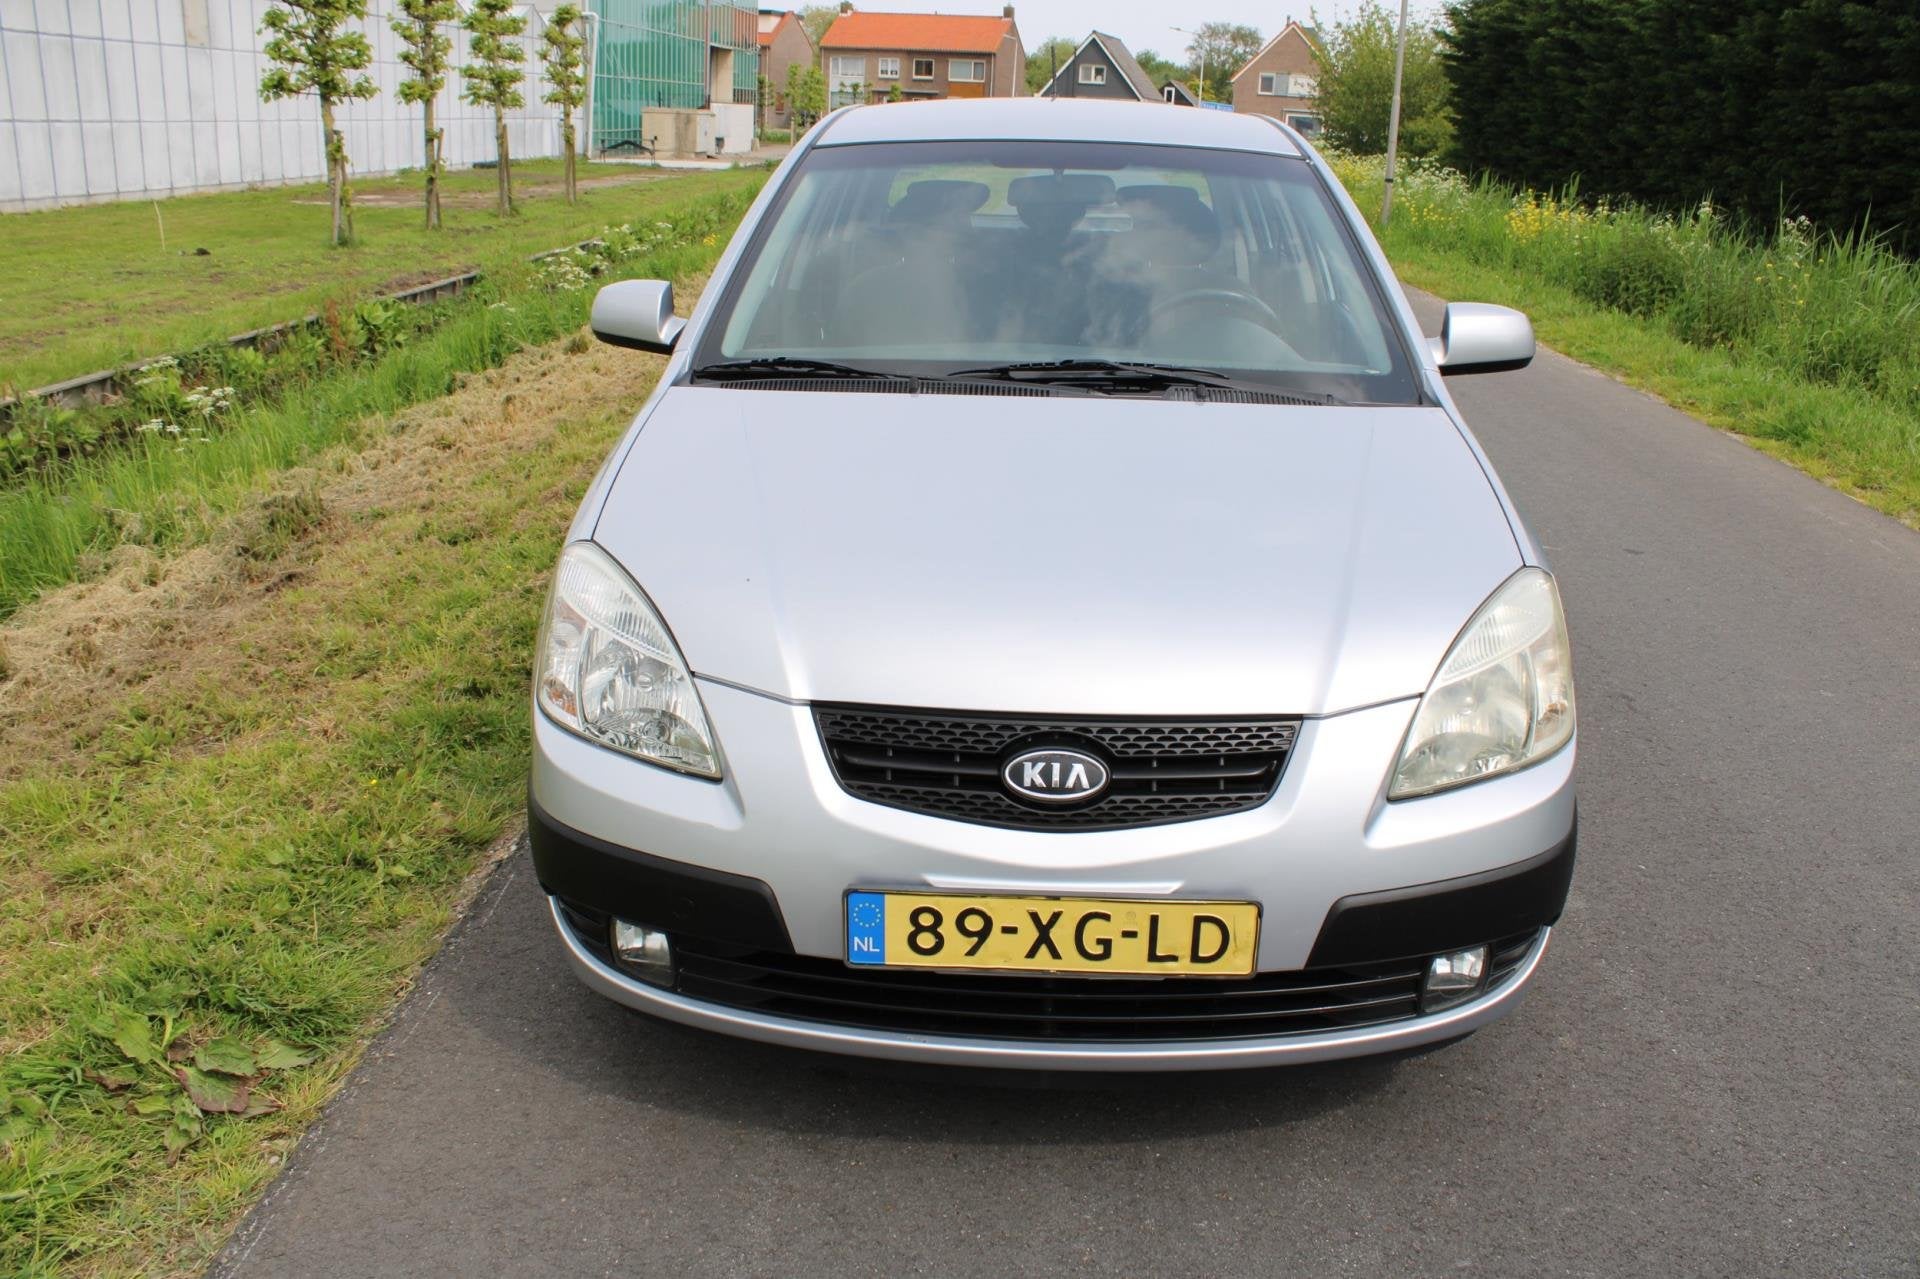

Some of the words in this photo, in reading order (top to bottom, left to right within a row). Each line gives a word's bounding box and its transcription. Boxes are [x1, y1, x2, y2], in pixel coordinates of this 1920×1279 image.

[1022, 761, 1090, 789] KIA
[853, 936, 880, 952] NL
[907, 905, 1231, 964] 89-XG-LD
